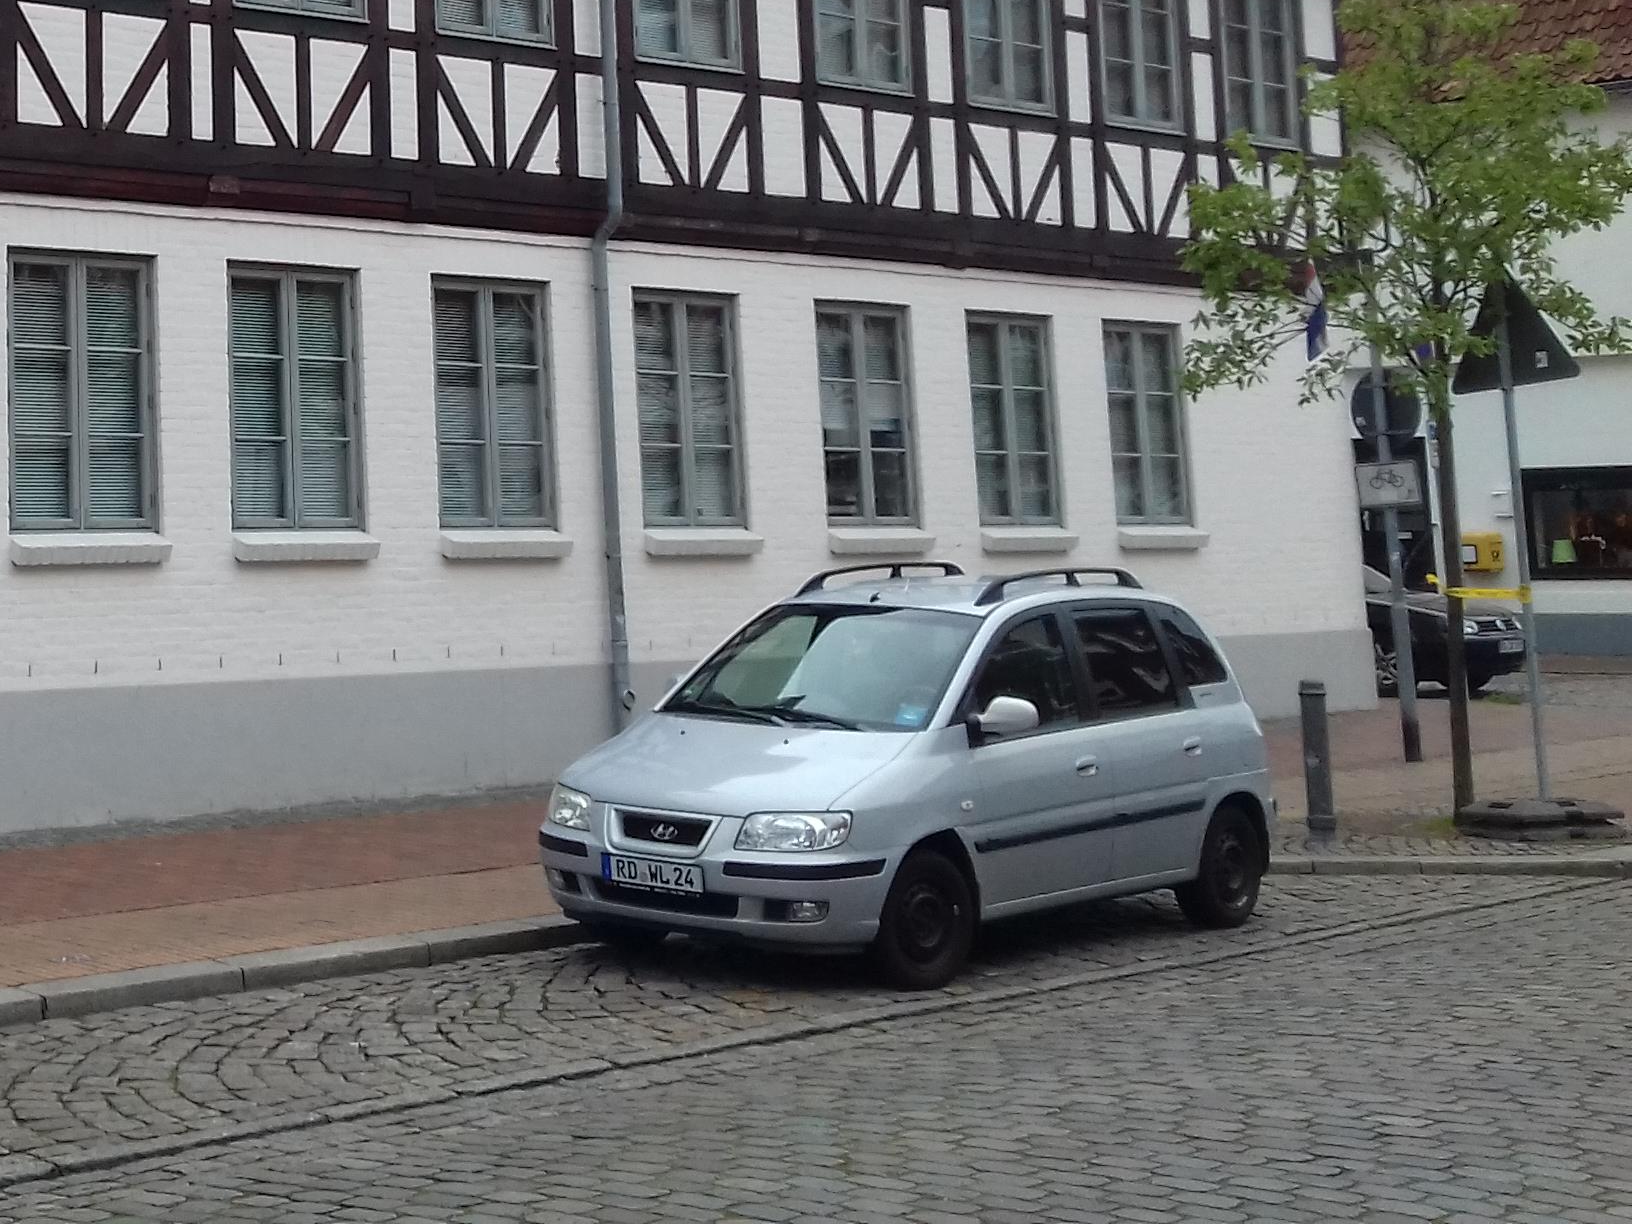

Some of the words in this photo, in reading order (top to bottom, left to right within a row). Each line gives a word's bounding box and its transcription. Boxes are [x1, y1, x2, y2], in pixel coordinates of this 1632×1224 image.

[616, 859, 638, 879] RD
[648, 863, 670, 884] WL
[673, 867, 695, 888] 24
